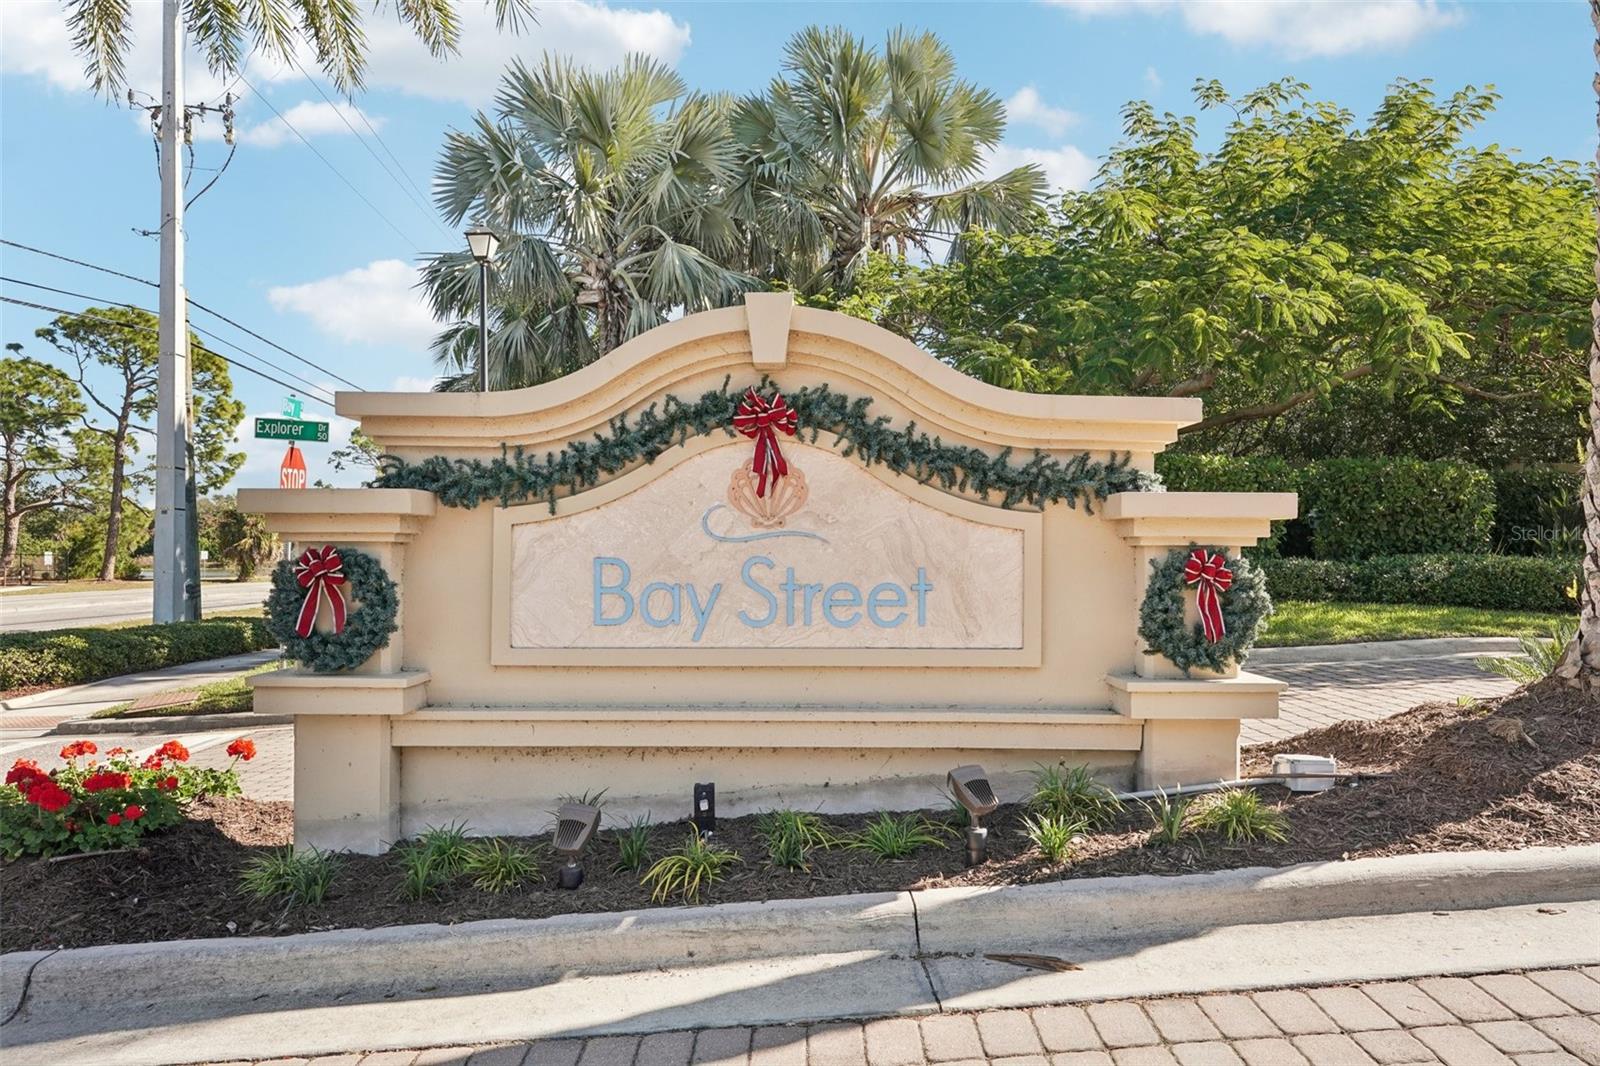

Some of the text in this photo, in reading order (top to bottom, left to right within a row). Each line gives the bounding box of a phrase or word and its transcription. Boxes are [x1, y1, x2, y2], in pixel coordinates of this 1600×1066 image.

[256, 420, 304, 437] Explorer
[317, 432, 327, 441] 50
[318, 424, 327, 432] Dr
[281, 468, 306, 489] STOP
[593, 555, 934, 642] Bay Street
